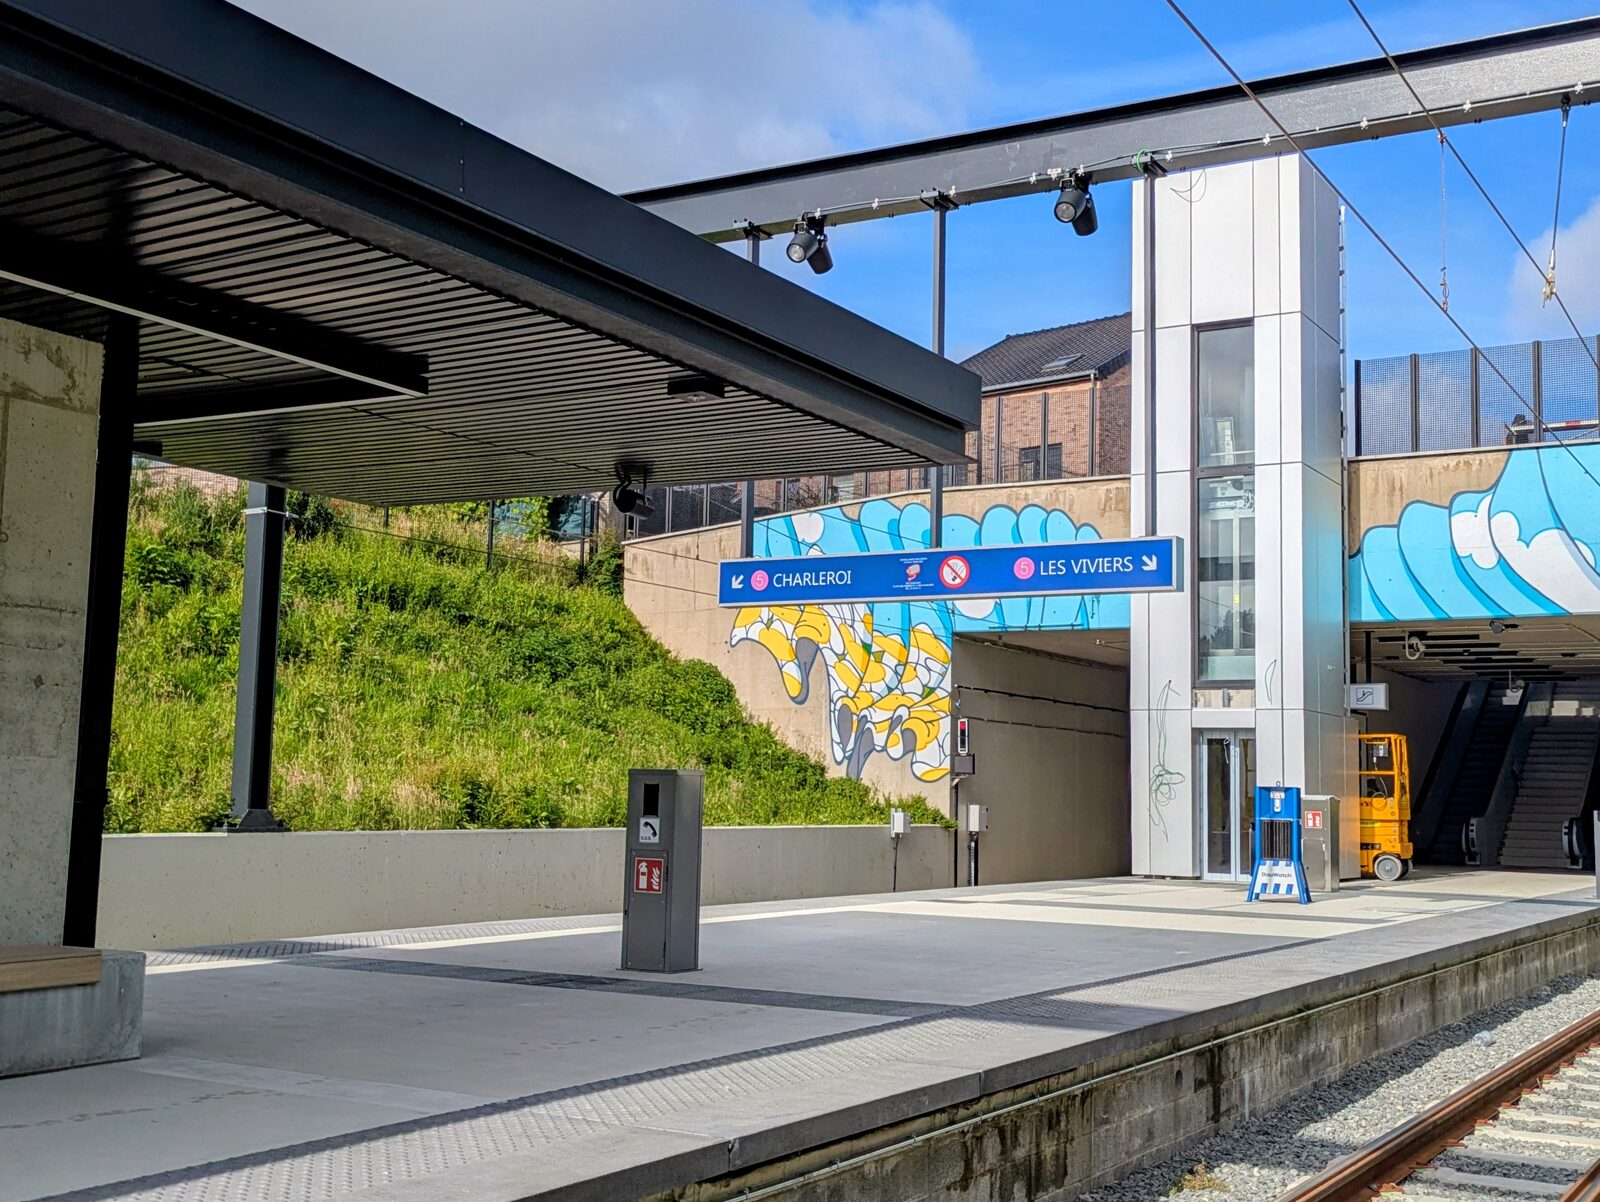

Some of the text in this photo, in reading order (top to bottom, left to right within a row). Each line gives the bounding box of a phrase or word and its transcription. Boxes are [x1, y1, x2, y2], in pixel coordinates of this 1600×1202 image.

[1020, 556, 1134, 576] 5 LES VIVIERS
[756, 570, 852, 588] 5 CHARLEROI
